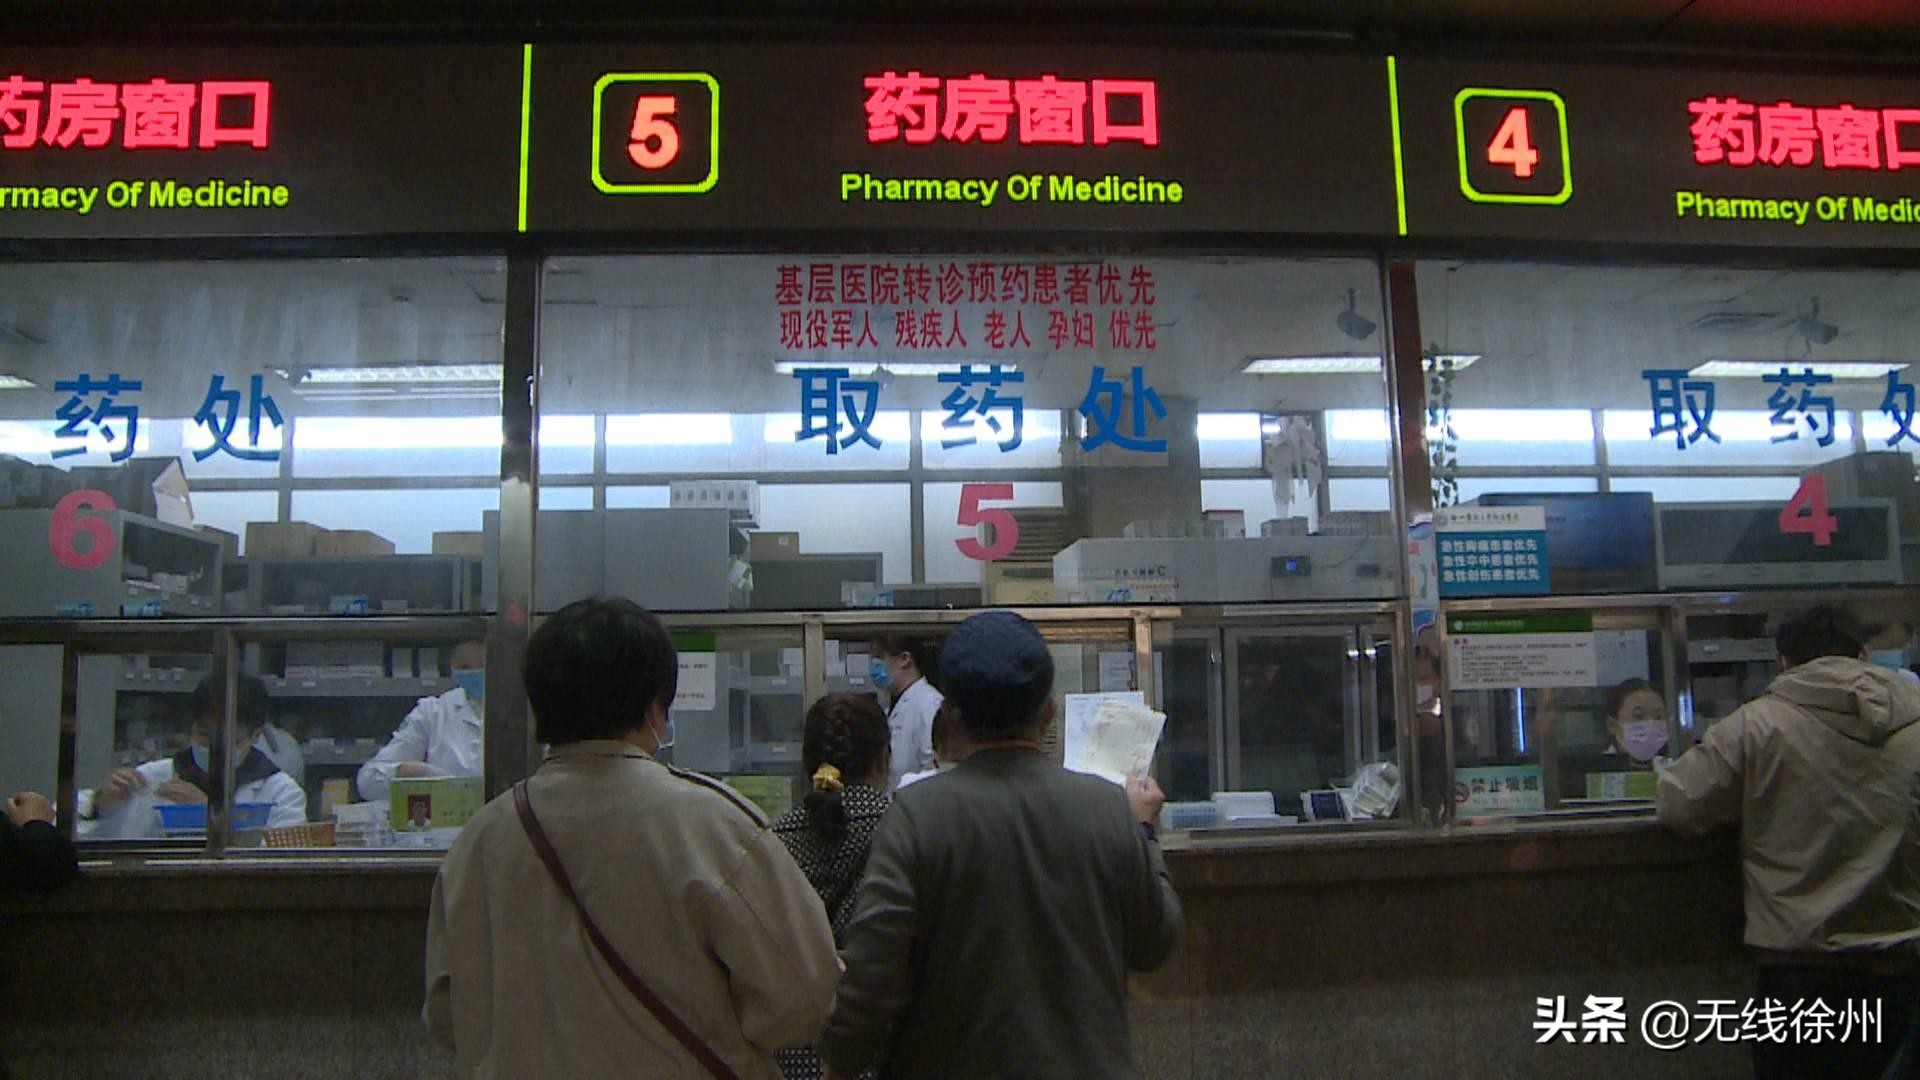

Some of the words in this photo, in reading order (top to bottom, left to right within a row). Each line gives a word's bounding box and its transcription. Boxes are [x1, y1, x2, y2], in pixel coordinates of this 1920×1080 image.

[628, 96, 679, 168] 5
[864, 72, 1158, 145] 药房窗口
[1488, 108, 1538, 176] 4
[1688, 97, 1920, 169] 药房窗口
[107, 182, 144, 207] Of
[150, 180, 288, 207] Medicine
[842, 174, 998, 206] Pharmacy
[1007, 175, 1042, 200] Of
[1049, 175, 1182, 202] Medicine
[1677, 192, 1809, 224] Pharmacy
[1816, 196, 1848, 220] Of
[775, 262, 1155, 306] 基层医院转诊预约患者优先
[779, 309, 878, 350] 现役军人
[895, 309, 967, 350] 残疾人
[984, 309, 1031, 350] 老人
[1048, 309, 1094, 350] 孕妇
[1109, 309, 1156, 350] 优先
[49, 489, 117, 571] 6
[955, 483, 1020, 561] 5
[1778, 471, 1839, 546] 4
